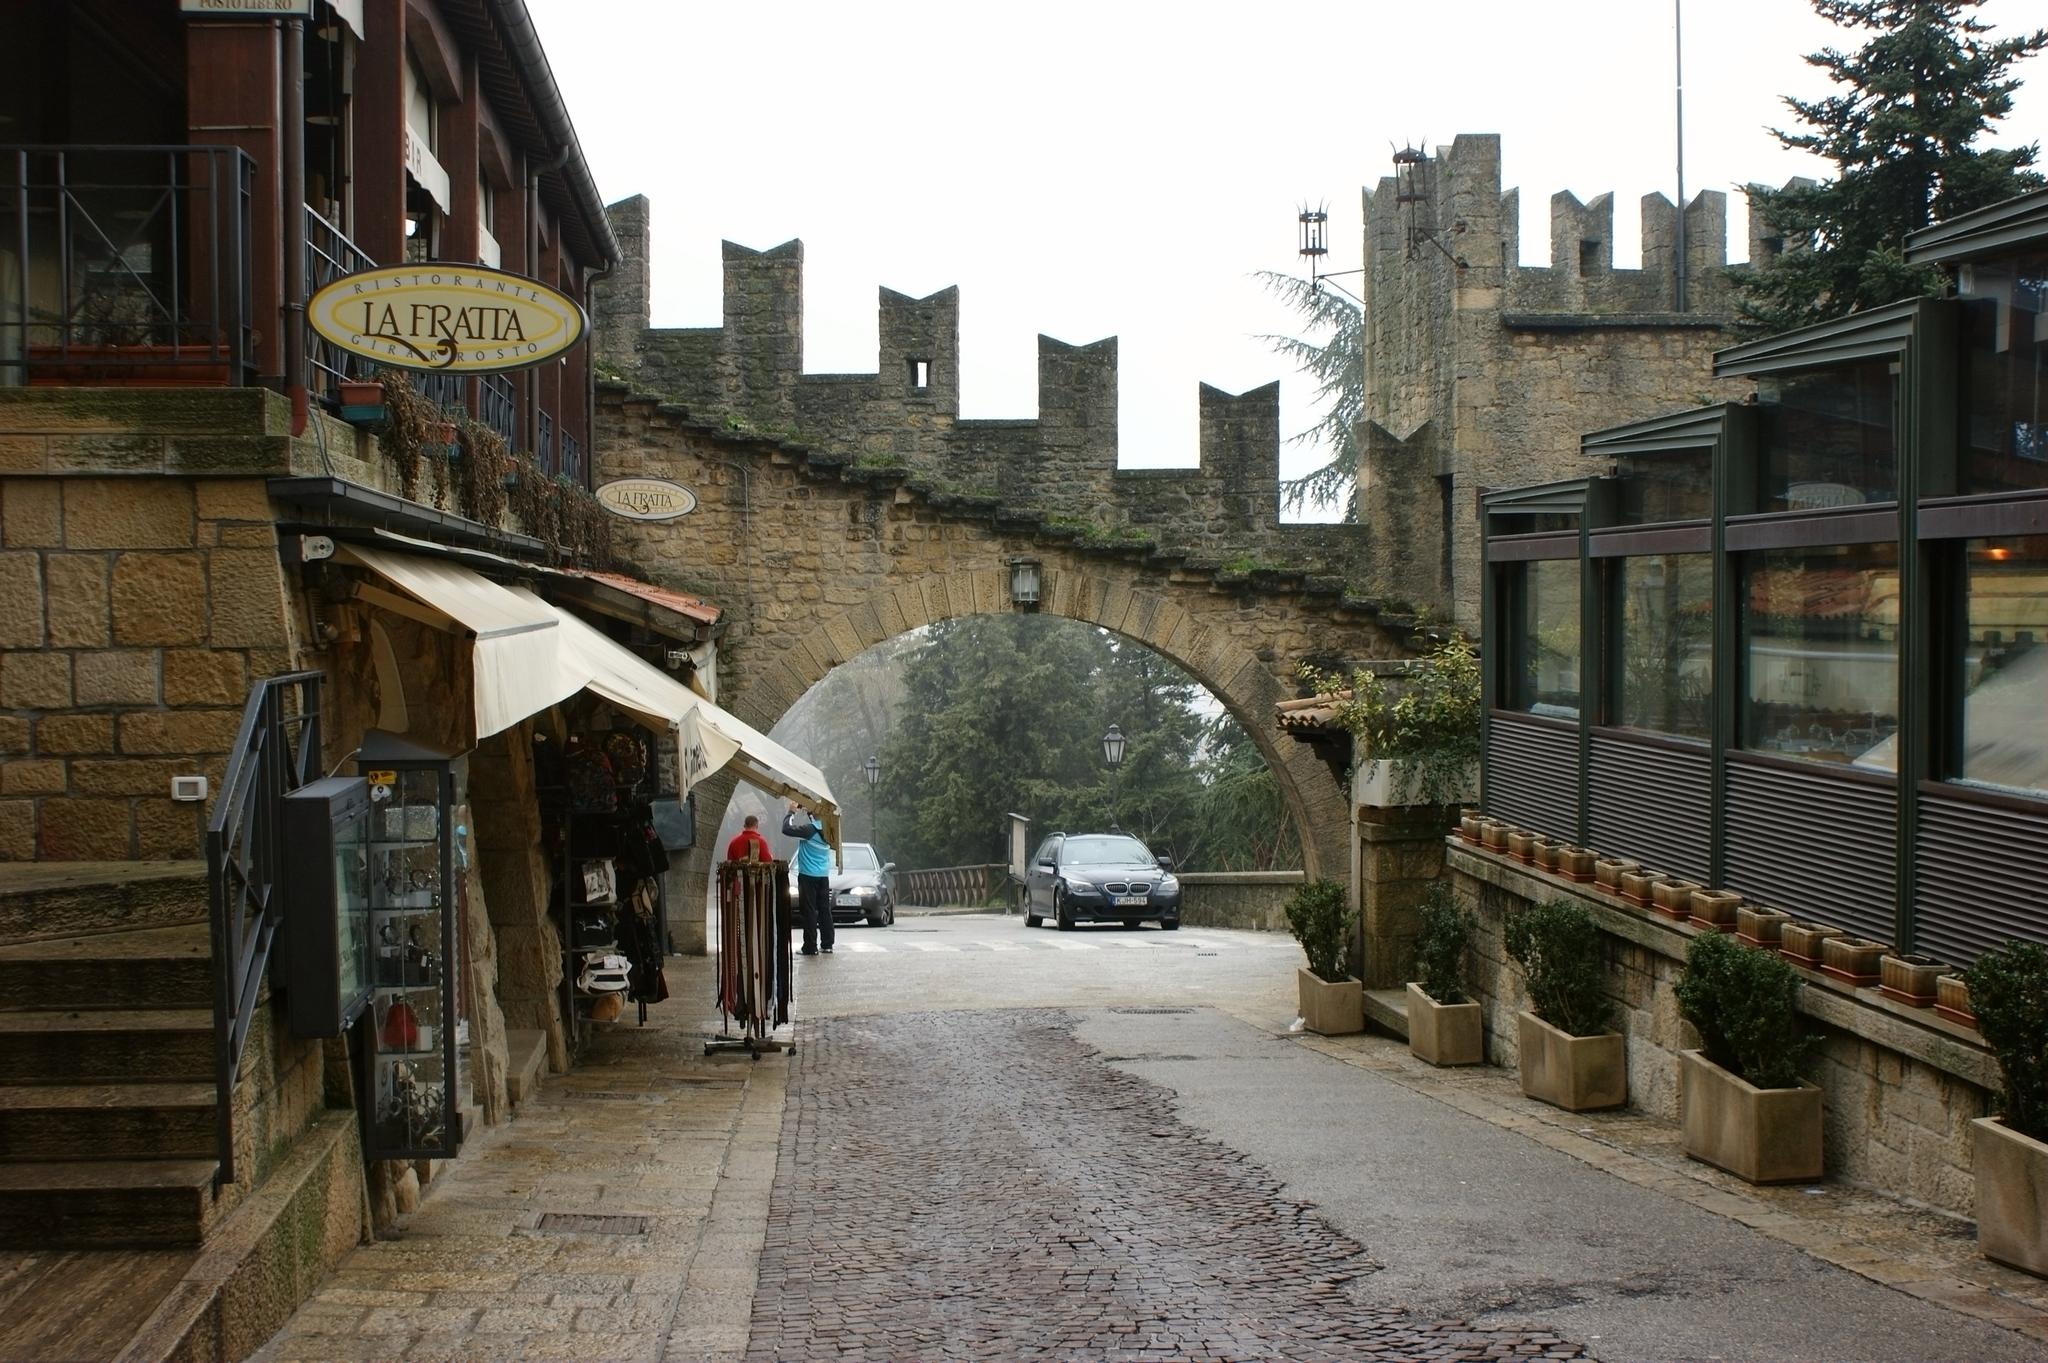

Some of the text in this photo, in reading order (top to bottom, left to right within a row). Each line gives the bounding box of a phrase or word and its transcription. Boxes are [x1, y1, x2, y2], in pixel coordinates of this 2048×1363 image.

[200, 0, 293, 10] POSTO LIBERO
[353, 274, 539, 303] RISTORANTE
[362, 301, 527, 344] LA FRATTA
[351, 333, 538, 362] GIRARROSTO
[633, 492, 673, 508] FRATTA
